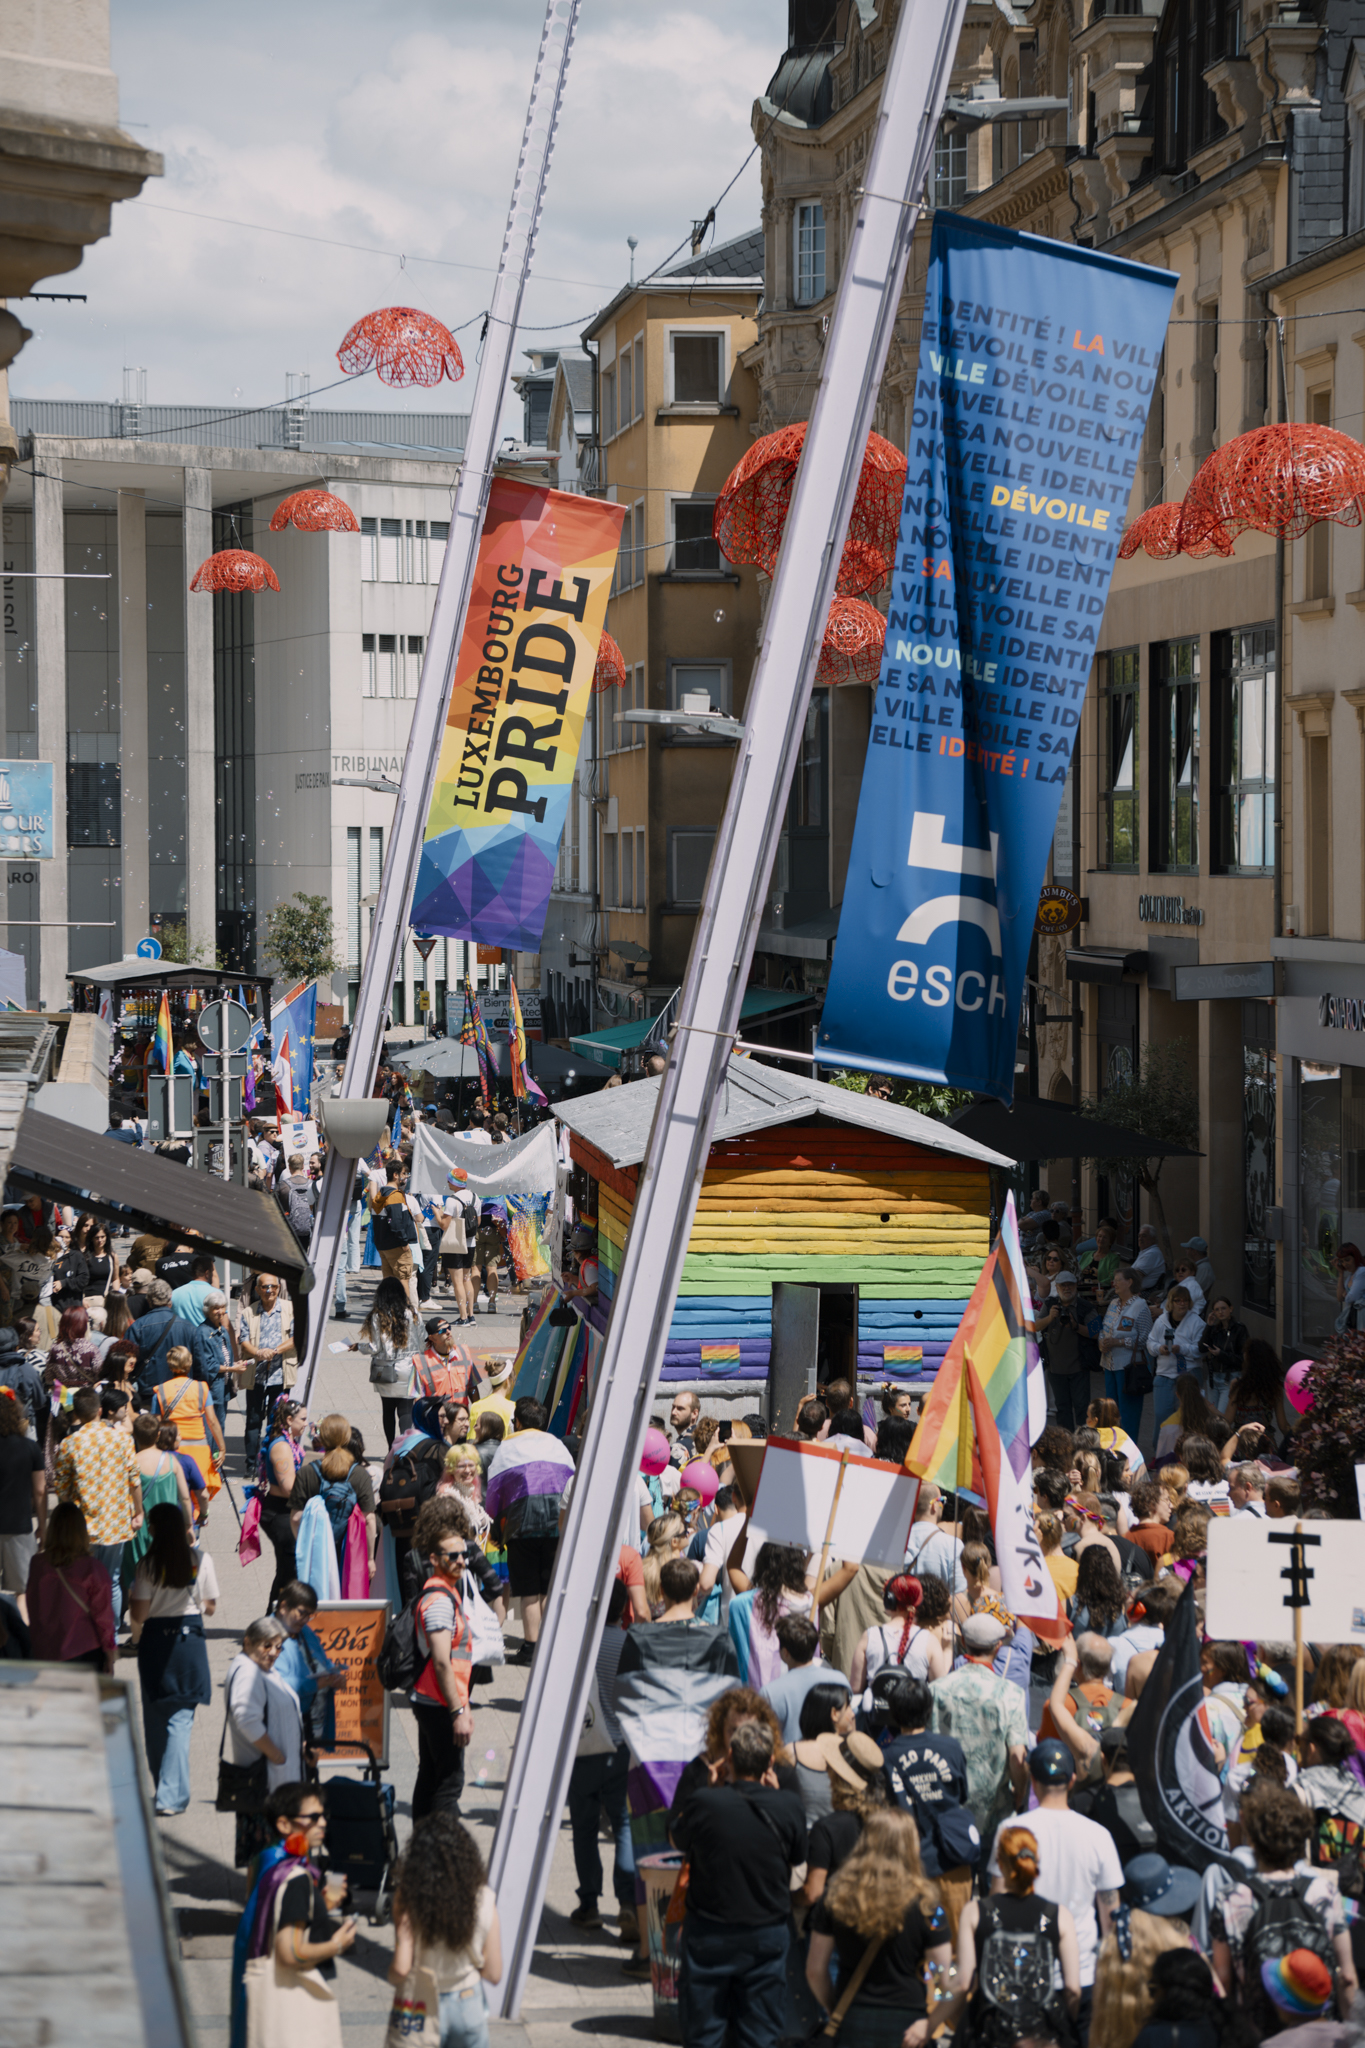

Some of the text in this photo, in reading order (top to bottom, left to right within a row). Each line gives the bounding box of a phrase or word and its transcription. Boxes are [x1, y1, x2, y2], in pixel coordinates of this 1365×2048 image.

[1072, 329, 1105, 356] LA
[1052, 354, 1086, 380] SA
[992, 367, 1110, 414] DÉVOILE
[1114, 399, 1147, 425] SA
[992, 427, 1137, 479] NOUVELLE
[991, 485, 1111, 532] DÉVOILE
[921, 557, 952, 581] SA
[1026, 553, 1111, 589] IDENT
[1062, 619, 1096, 645] SA
[453, 563, 525, 810] LUXEMBOURG
[484, 568, 591, 823] PRIDE
[906, 672, 937, 696] SA
[1002, 665, 1086, 701] IDENT
[884, 697, 955, 727] VILLE
[1036, 732, 1070, 758] SA
[1035, 761, 1067, 786] LA
[1197, 973, 1270, 991] SWAROVSKI
